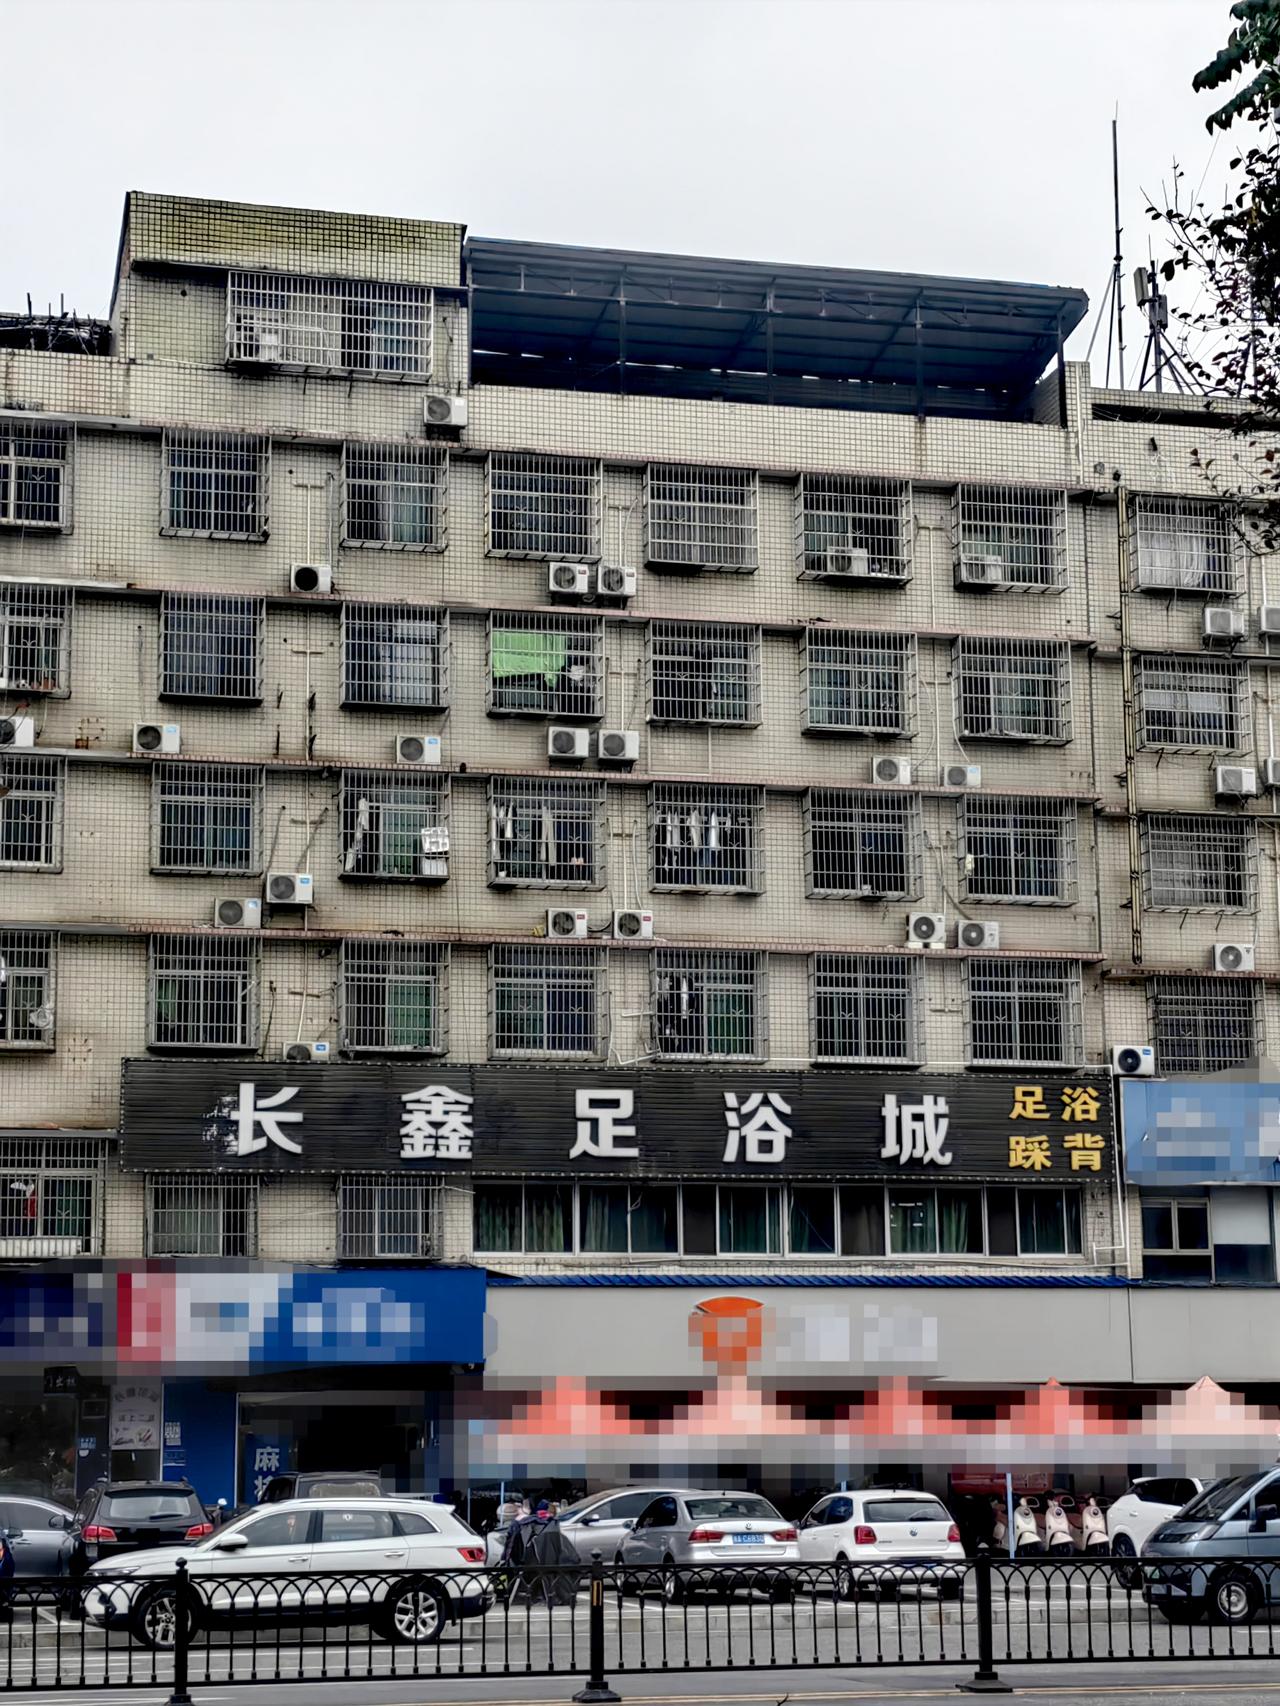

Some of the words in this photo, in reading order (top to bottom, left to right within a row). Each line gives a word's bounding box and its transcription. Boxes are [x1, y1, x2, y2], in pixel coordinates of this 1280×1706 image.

[1009, 1085, 1101, 1122] 足浴
[231, 1082, 953, 1167] 长鑫足浴城
[1009, 1133, 1105, 1171] 踩背
